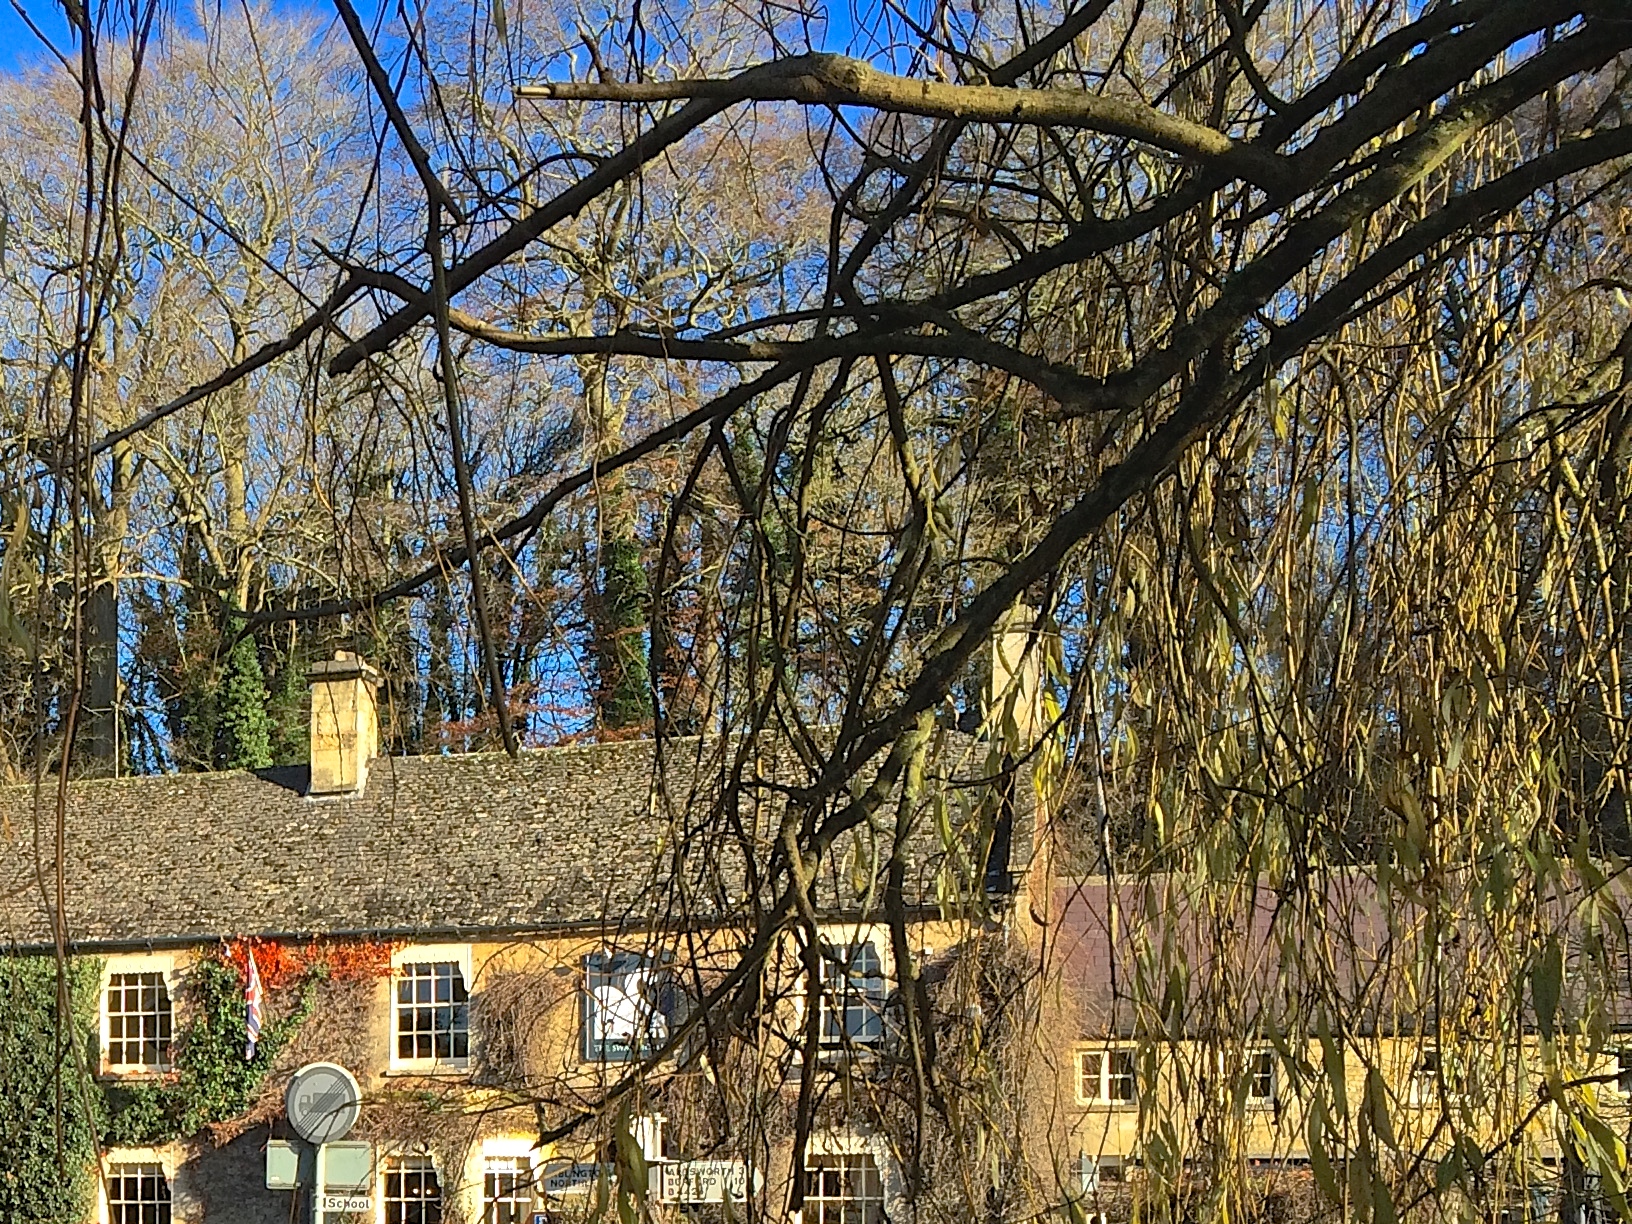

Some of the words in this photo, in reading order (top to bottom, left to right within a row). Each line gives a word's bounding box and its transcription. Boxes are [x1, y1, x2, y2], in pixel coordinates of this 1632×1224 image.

[738, 1167, 745, 1175] 3
[734, 1177, 745, 1185] 10
[328, 1198, 369, 1209] School
